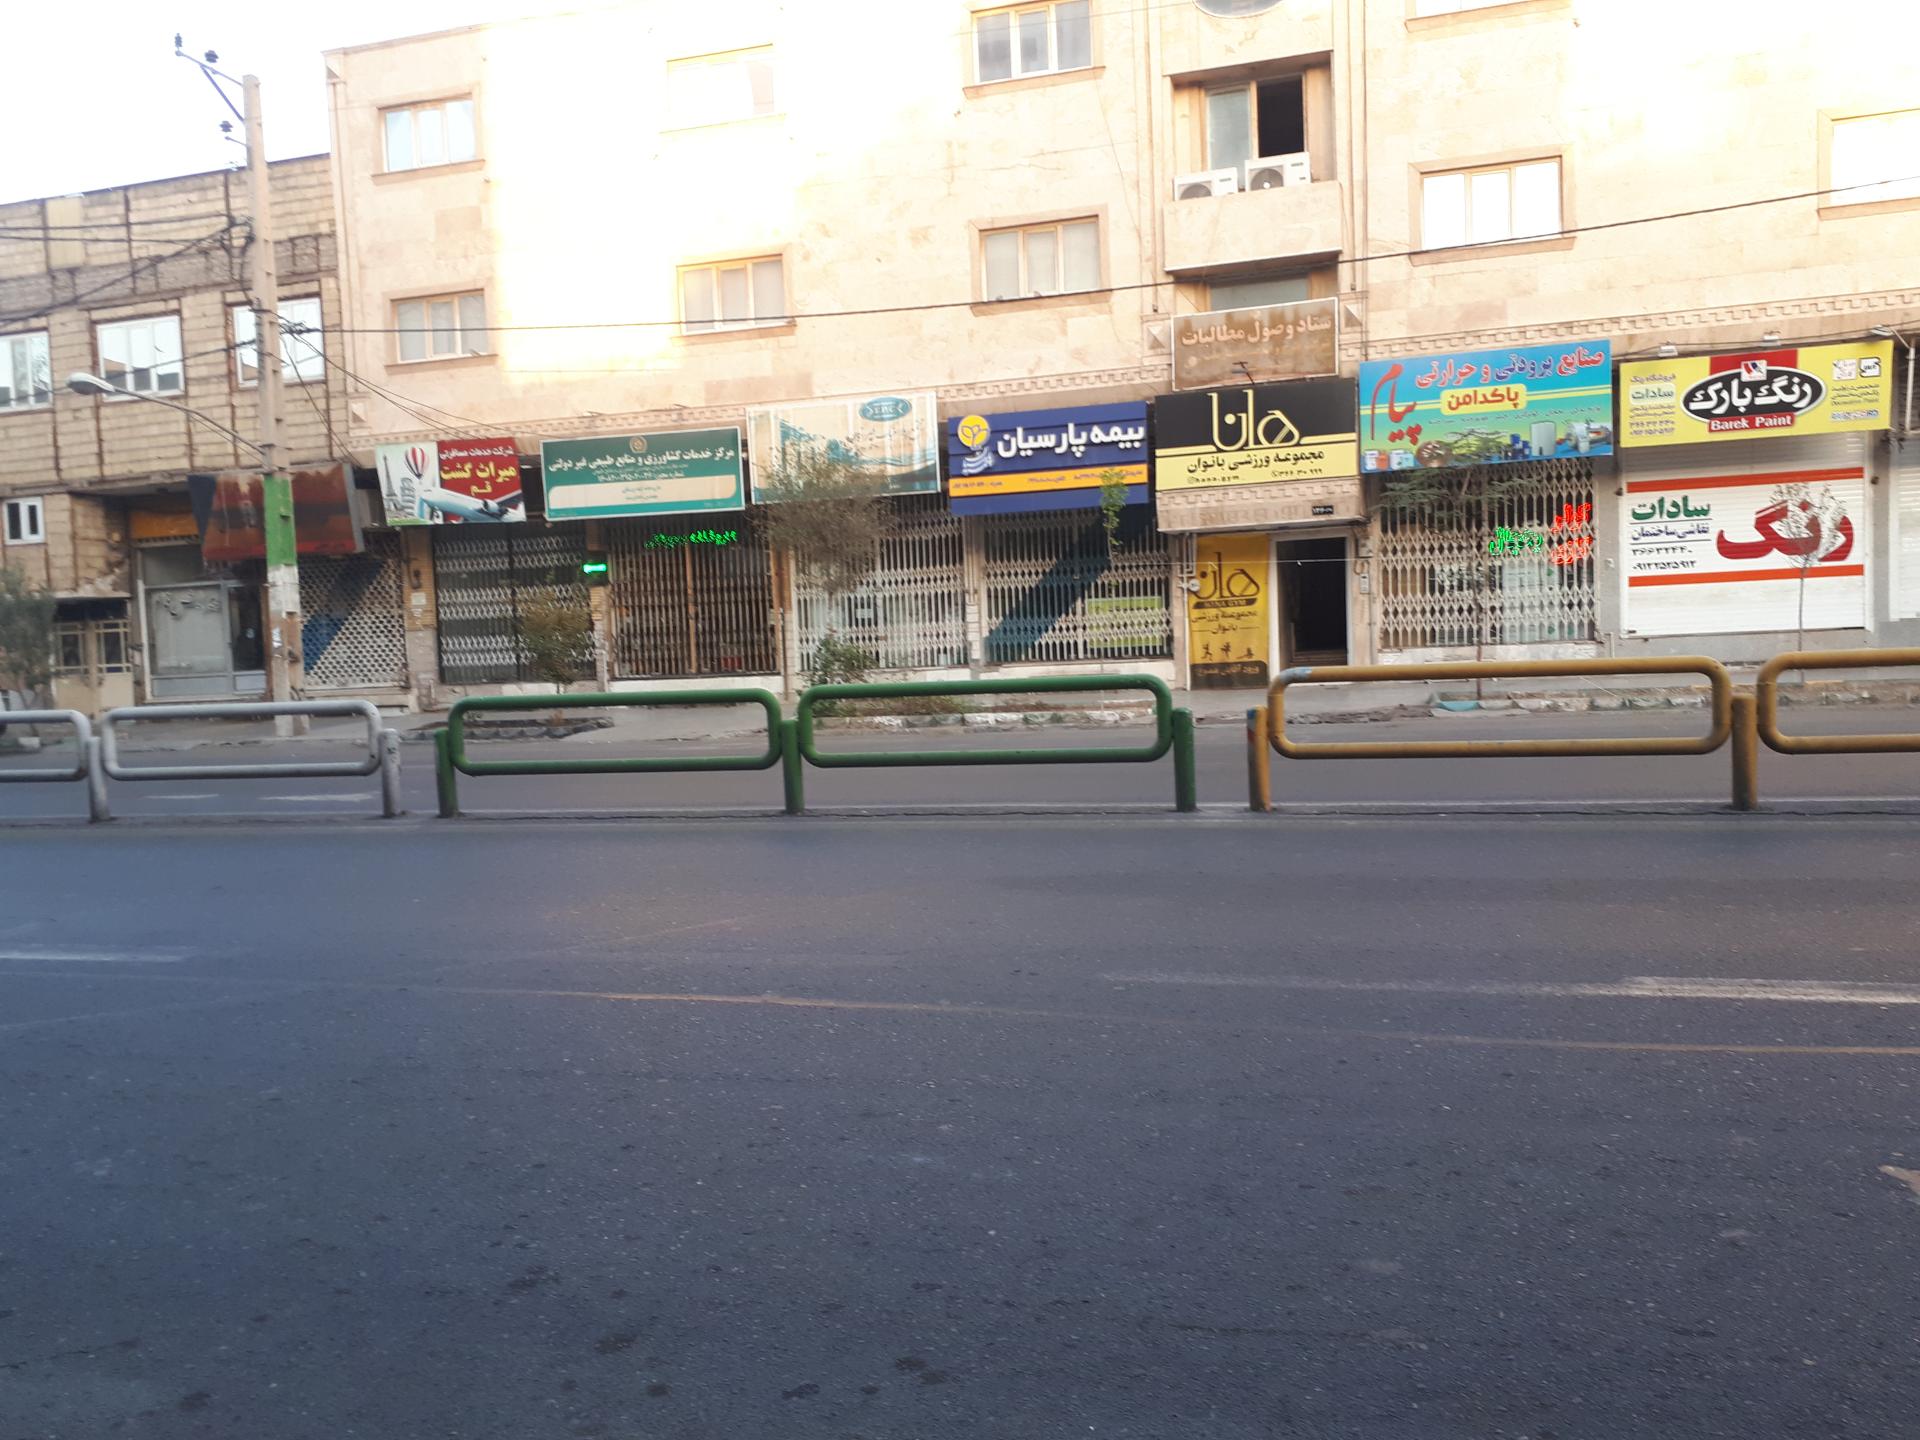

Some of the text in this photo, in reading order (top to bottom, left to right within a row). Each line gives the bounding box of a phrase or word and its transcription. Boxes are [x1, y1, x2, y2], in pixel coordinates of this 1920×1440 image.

[1181, 315, 1331, 348] ستاد وصول مطالبات
[1415, 346, 1604, 388] صنایع برودتی و حرارتی
[1447, 387, 1519, 411] پاکدامن
[1631, 388, 1674, 400] سادات
[1689, 375, 1814, 415] رنگ بارک
[1207, 389, 1300, 451] هانا
[1711, 415, 1792, 431] Barek Paint
[996, 422, 1146, 458] بیمه پارسیان
[440, 446, 514, 460] شرکت خدمات مسافرتی
[615, 453, 637, 467] منابع
[643, 450, 681, 466] کشاورزی
[682, 447, 712, 460] خدمات
[715, 446, 735, 461] مرکز
[549, 457, 573, 473] دولتی
[574, 456, 587, 471] غیر
[588, 454, 615, 470] طبیعی
[637, 456, 643, 467] و
[1187, 450, 1324, 473] مجموعه ورزشی بانوان
[440, 461, 518, 483] میراث گشت
[470, 480, 493, 496] قم
[1631, 495, 1711, 521] سادات
[1631, 522, 1710, 541] نقاشی ساختمان
[1716, 500, 1854, 562] رنگ
